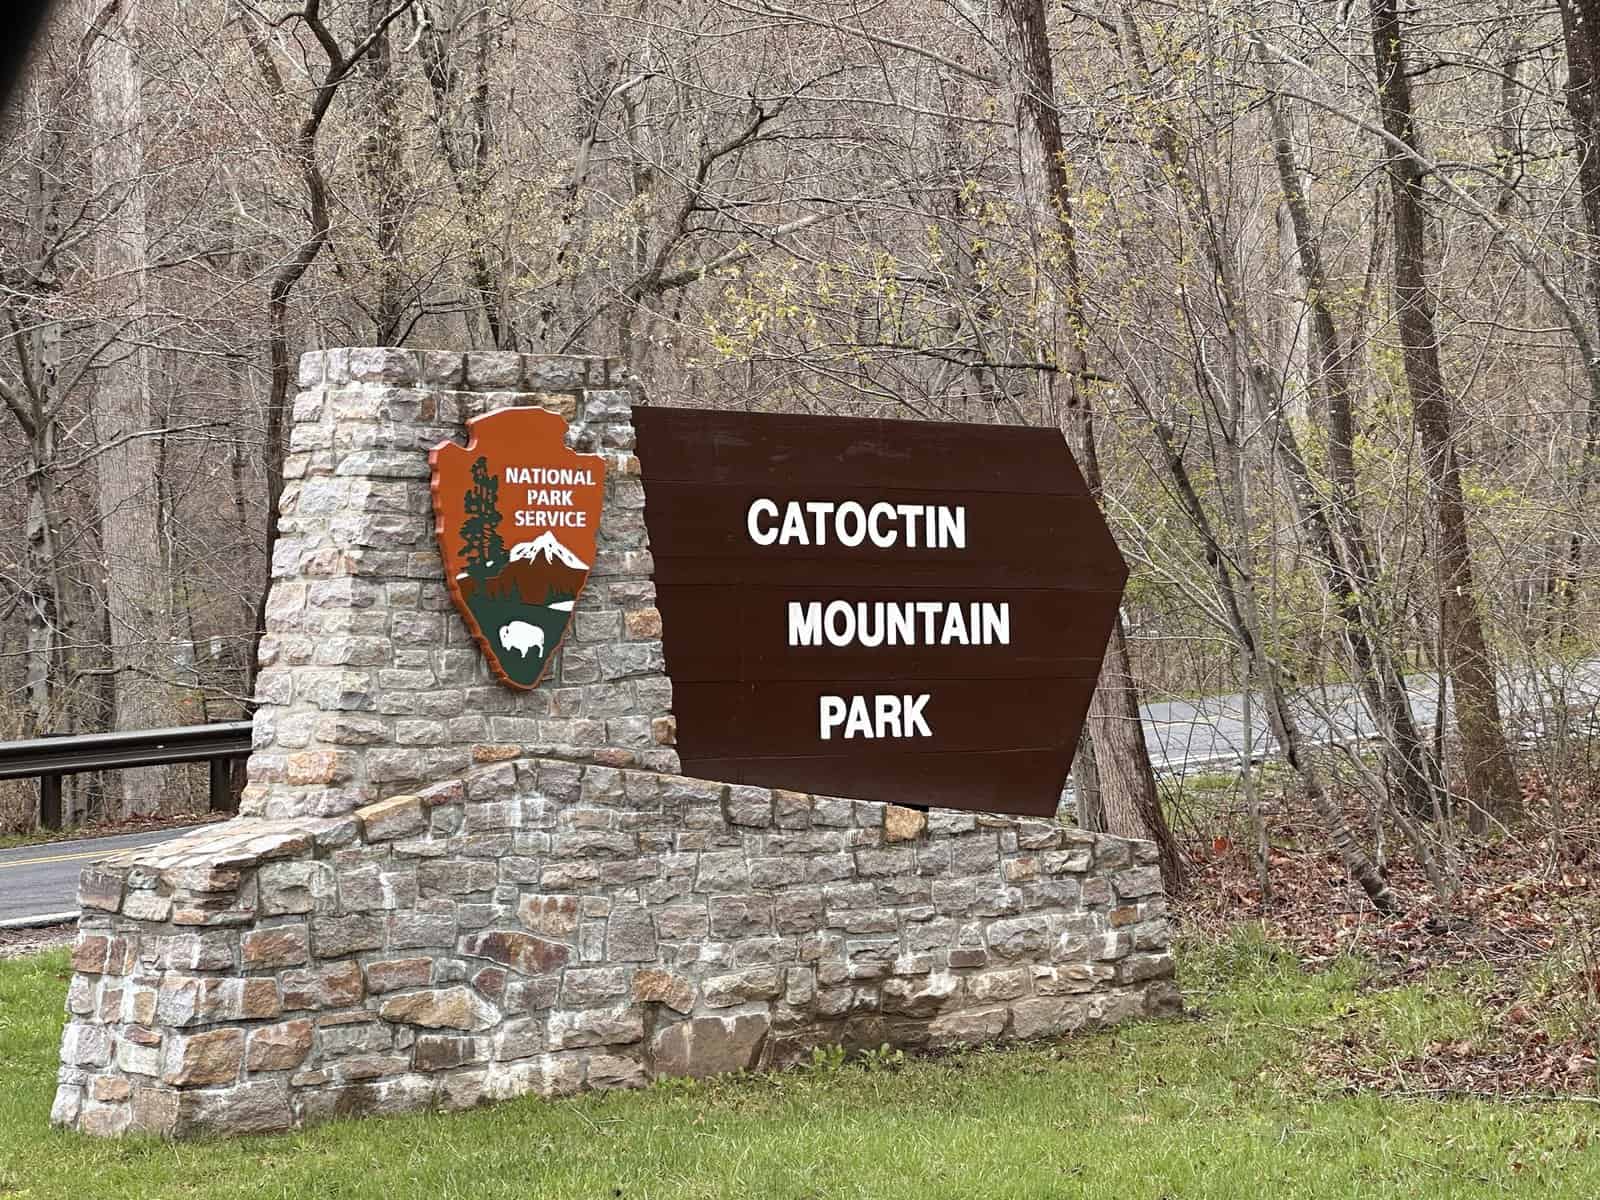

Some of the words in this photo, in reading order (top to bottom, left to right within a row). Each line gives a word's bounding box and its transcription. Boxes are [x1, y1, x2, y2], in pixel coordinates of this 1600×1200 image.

[505, 467, 596, 486] NATIONAL
[527, 489, 574, 506] PARK
[514, 510, 586, 527] SERVICE
[747, 498, 966, 549] CATOCTIN
[788, 600, 1010, 647] MOUNTAIN
[820, 694, 933, 740] PARK
